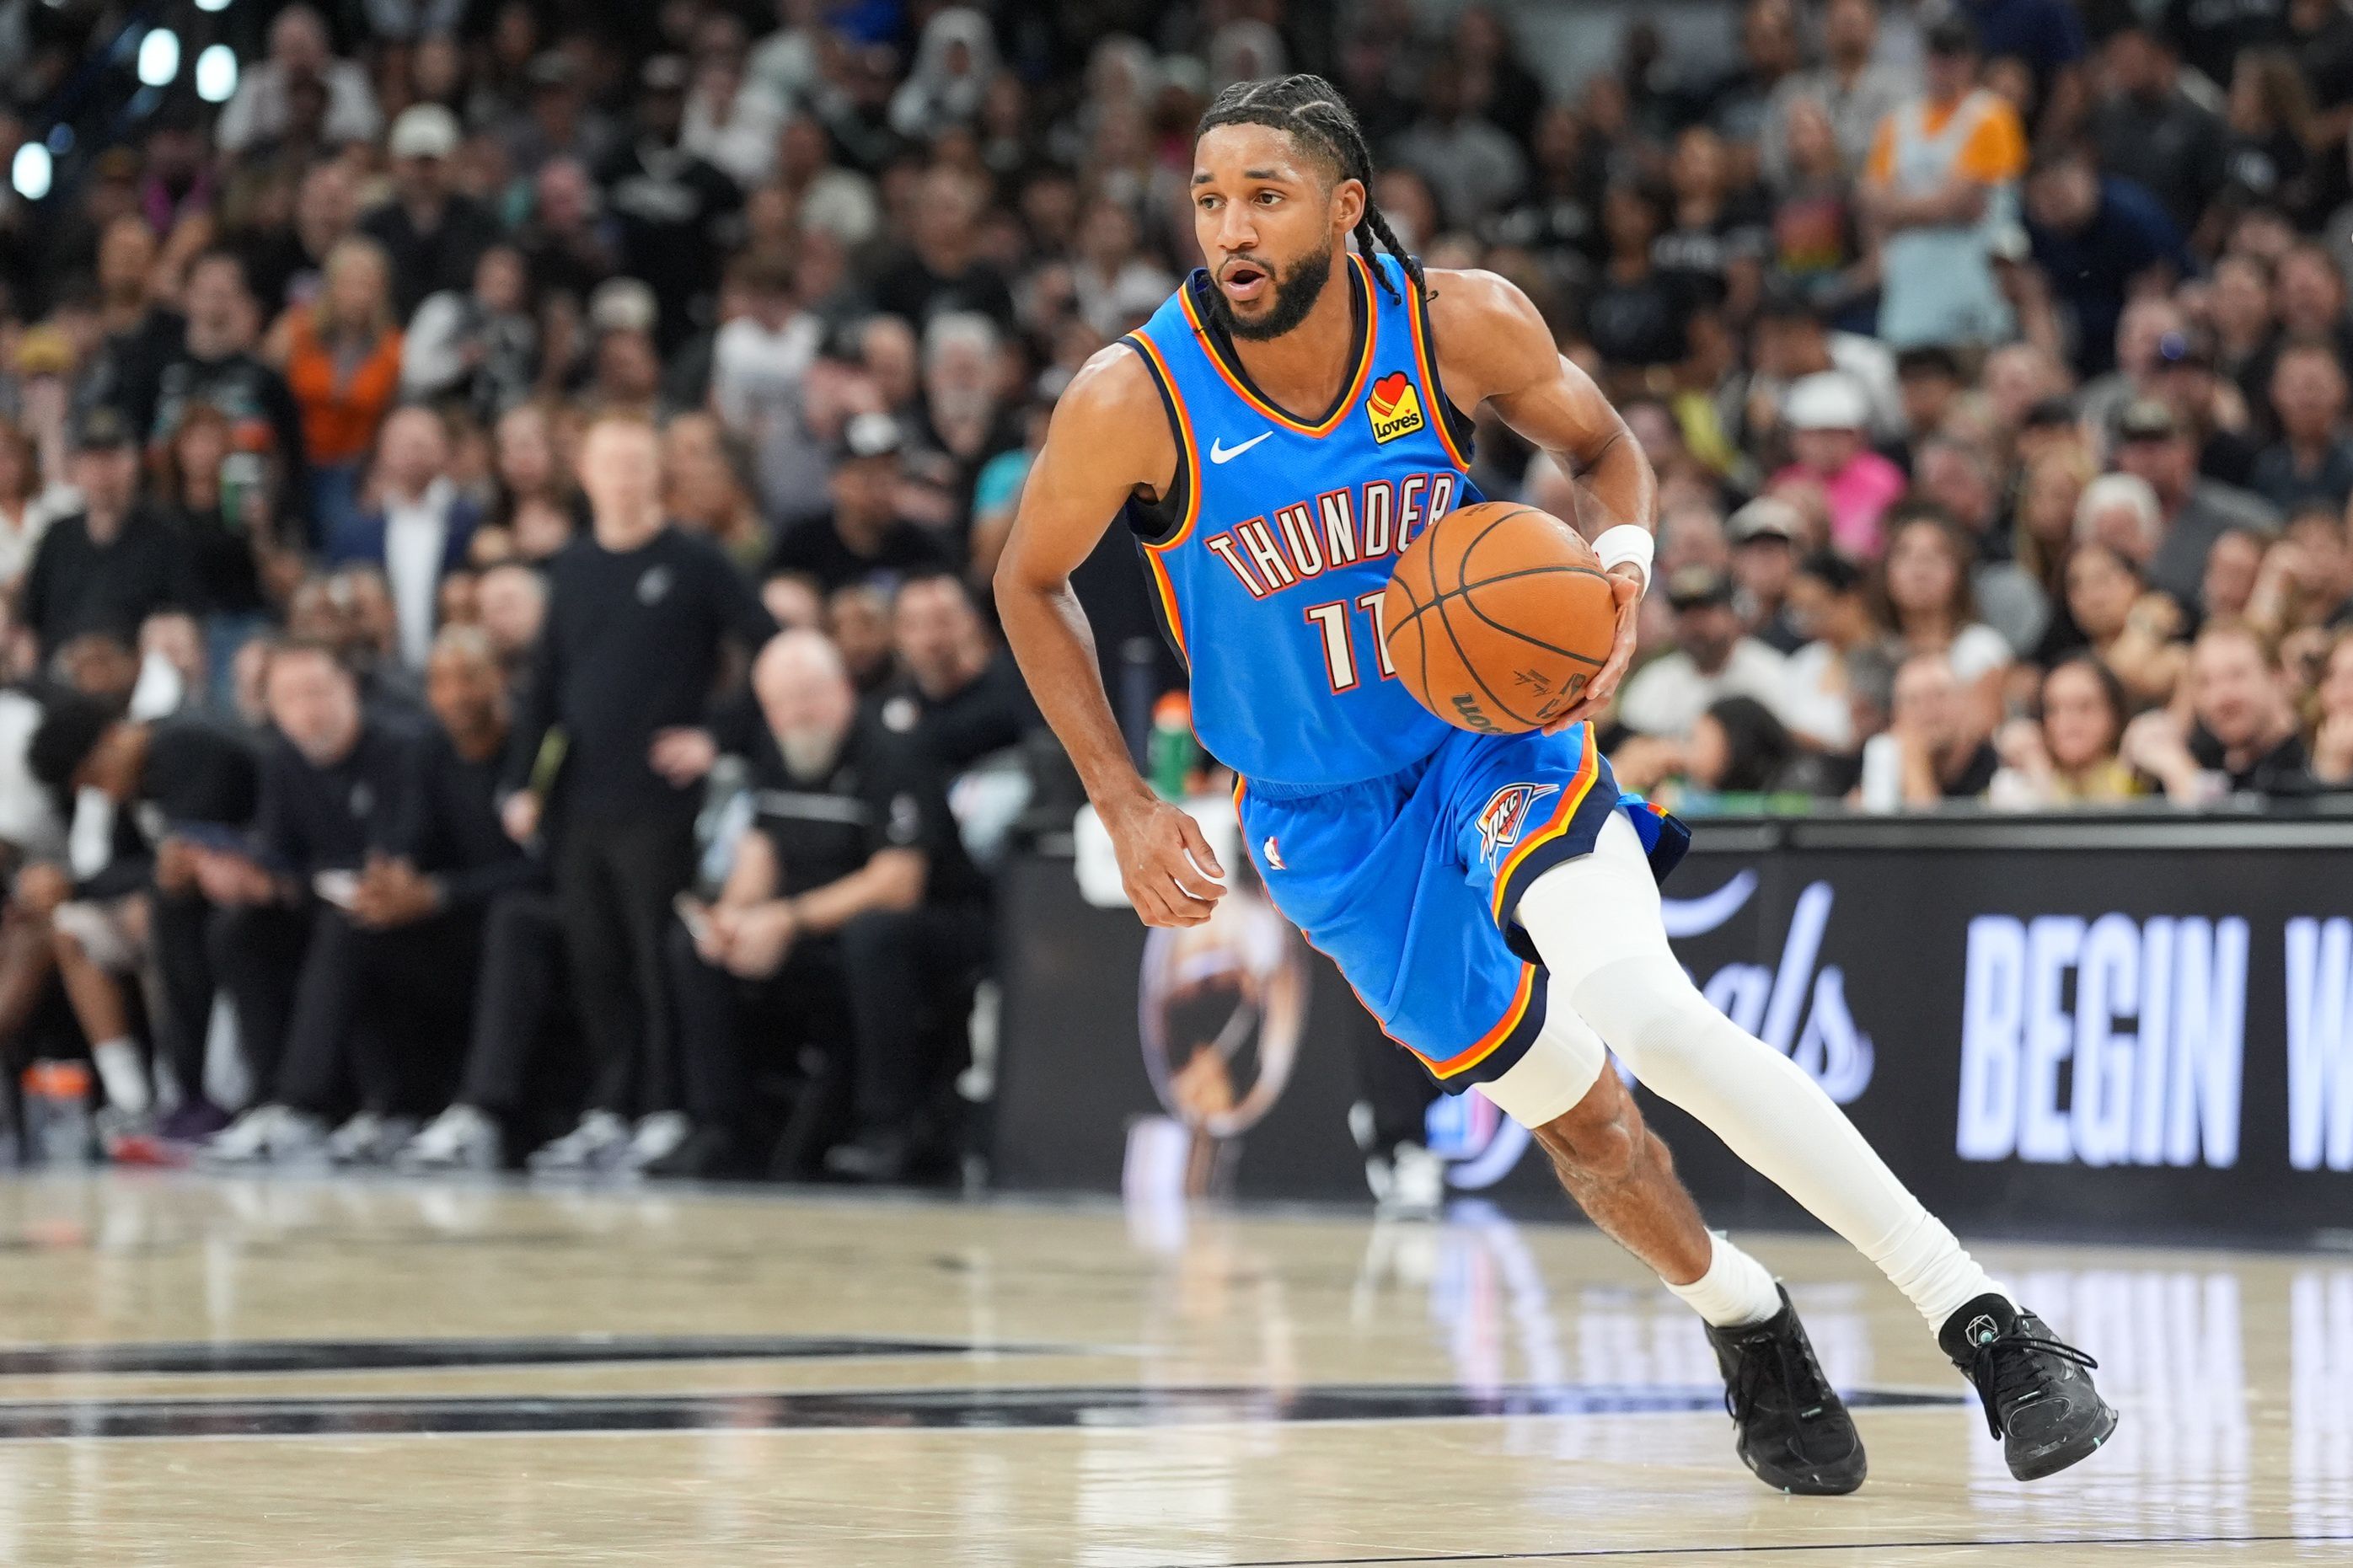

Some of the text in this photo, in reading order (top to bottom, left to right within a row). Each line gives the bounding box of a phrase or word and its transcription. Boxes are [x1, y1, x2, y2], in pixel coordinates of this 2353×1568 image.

[1204, 473, 1455, 601] THUNDER
[1303, 587, 1397, 696] 11
[1955, 912, 2251, 1169] BEGIN
